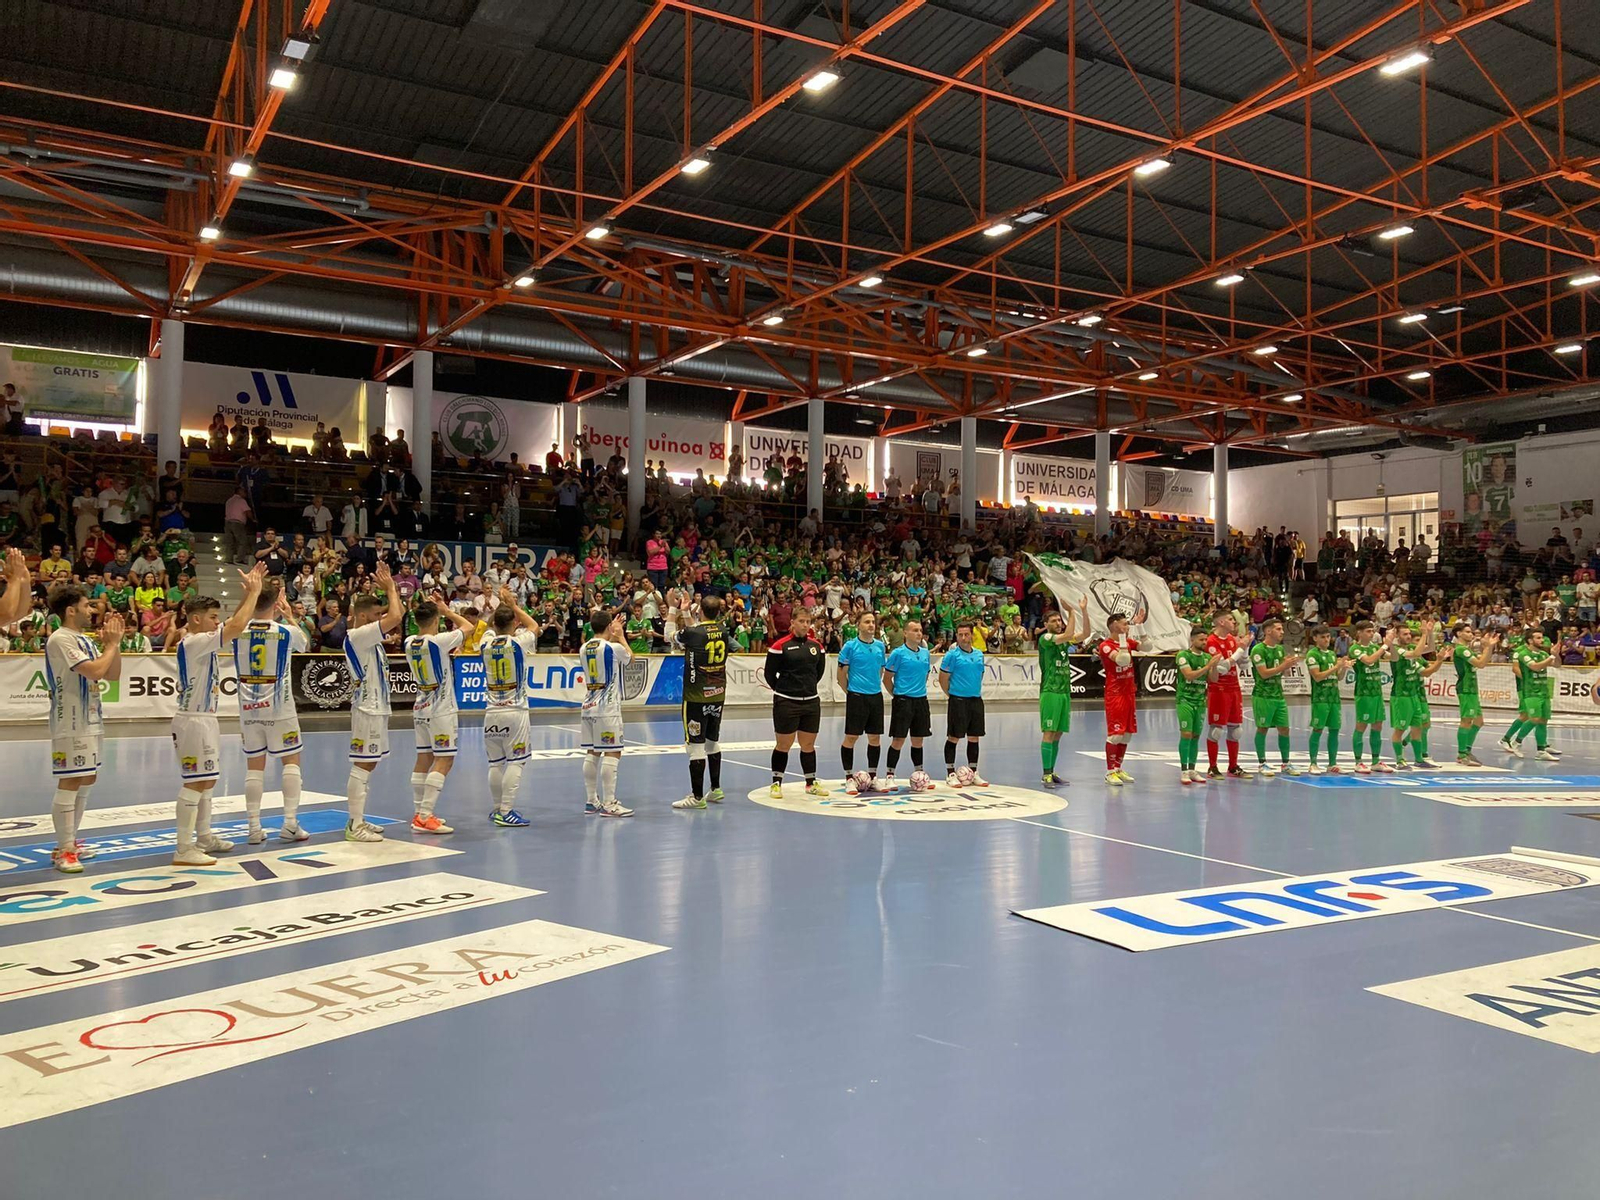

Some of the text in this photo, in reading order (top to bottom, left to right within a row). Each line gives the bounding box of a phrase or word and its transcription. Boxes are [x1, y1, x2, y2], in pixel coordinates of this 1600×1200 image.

[53, 366, 100, 379] GRATIS
[91, 359, 119, 369] AGUA
[217, 404, 319, 422] Diputación Provincial
[243, 417, 293, 429] de álaga
[583, 424, 702, 455] iberouinoa
[750, 435, 863, 459] UNIVERIDAD
[1017, 481, 1096, 498] DE MÁLAGA
[1120, 598, 1136, 607] CLUB
[707, 632, 722, 640] TOMY
[251, 644, 267, 670] 3
[705, 640, 726, 664] 13
[461, 662, 485, 673] SIN
[488, 657, 512, 680] 10
[461, 677, 480, 688] NO
[1560, 681, 1595, 697] BES
[26, 892, 475, 977] Unicaja Banco
[318, 989, 450, 1023] Directa
[478, 968, 519, 987] tu
[518, 942, 625, 973] corazón
